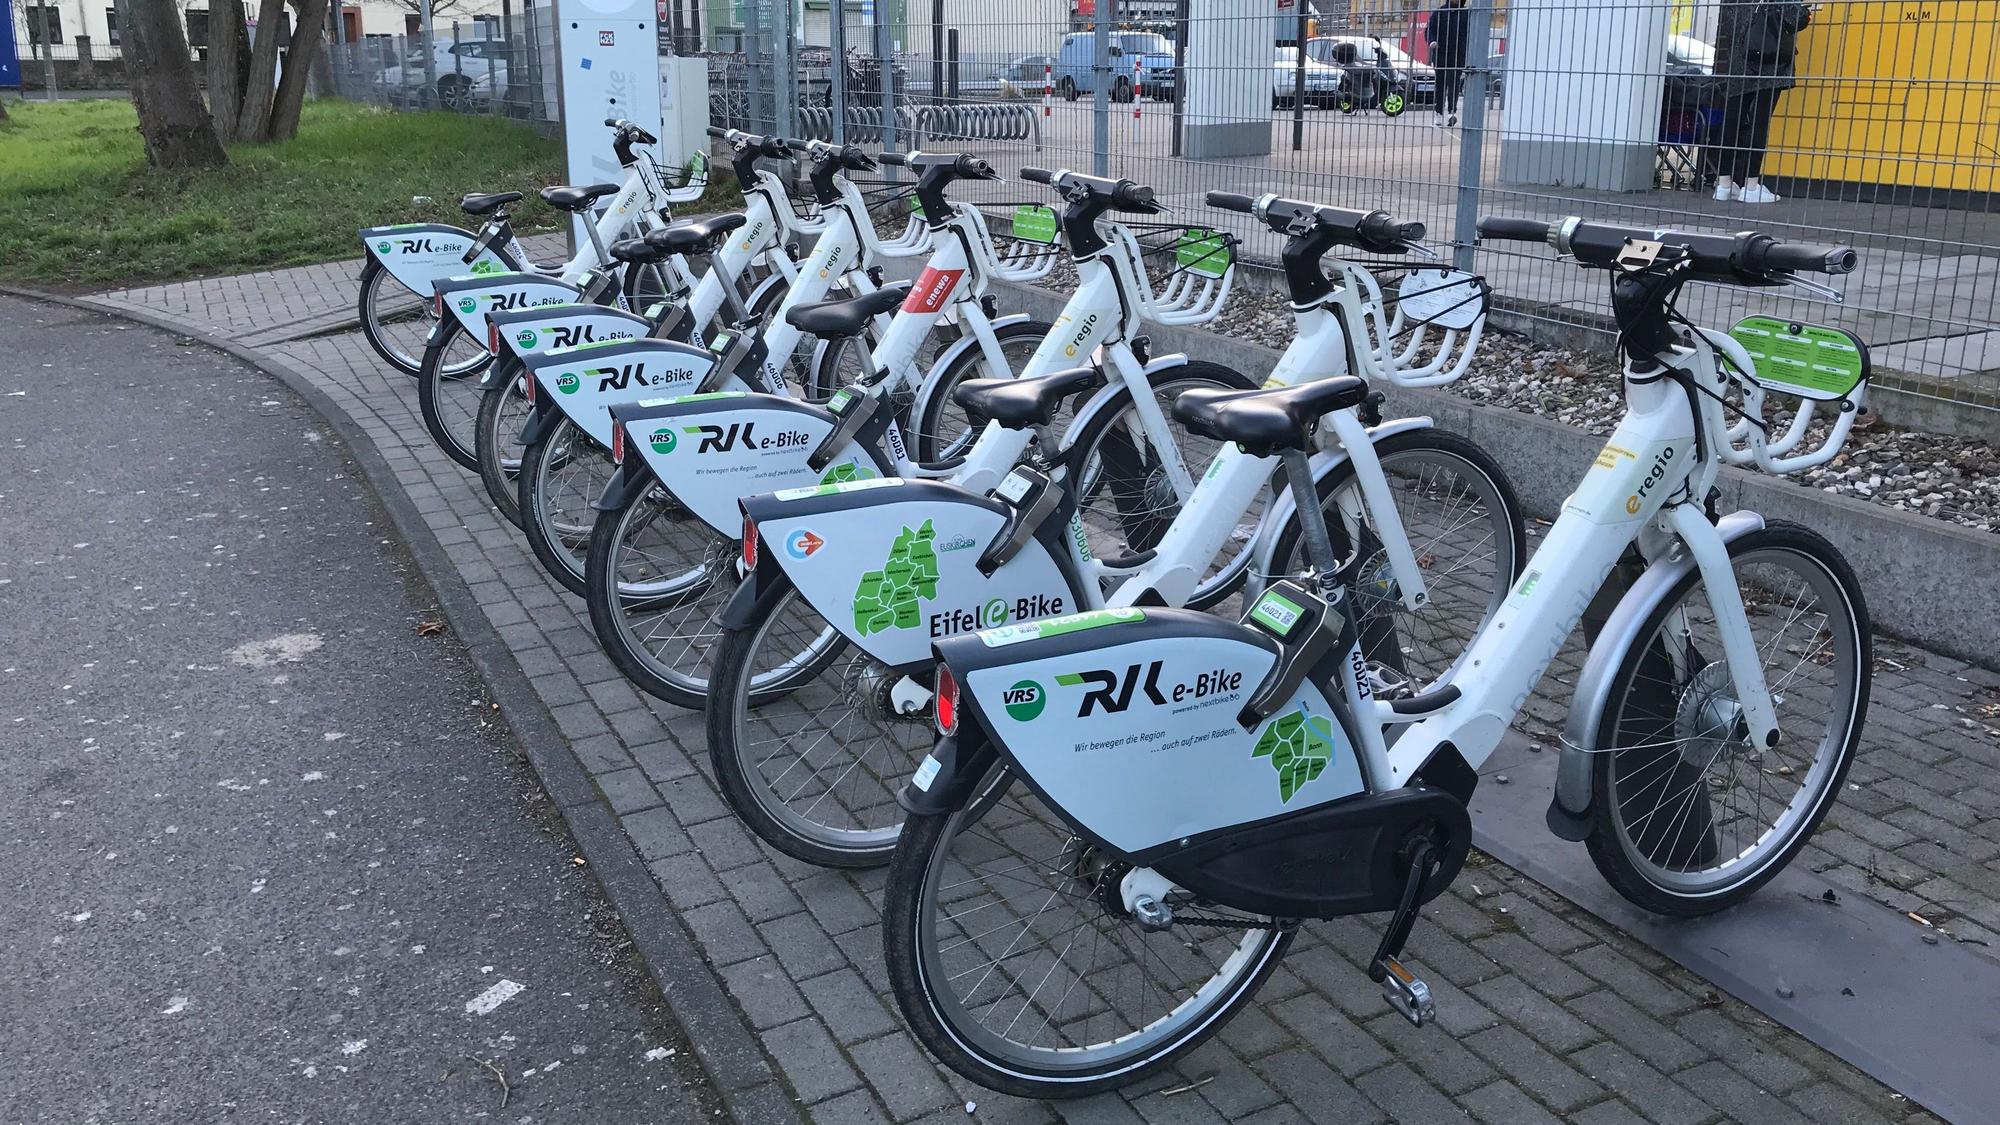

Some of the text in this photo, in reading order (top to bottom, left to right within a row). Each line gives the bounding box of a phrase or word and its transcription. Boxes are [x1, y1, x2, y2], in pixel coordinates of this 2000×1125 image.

[1905, 12, 1918, 20] XL
[434, 243, 462, 253] e-Bike
[458, 300, 472, 308] VRS
[516, 333, 532, 341] VRS
[556, 377, 574, 386] VRS
[652, 368, 693, 385] e-Bike
[767, 362, 783, 391] 46006
[649, 434, 670, 443] VRS
[761, 431, 810, 450] e-Bike
[889, 428, 905, 461] 46081
[705, 467, 729, 476] bewegen
[730, 466, 739, 474] die
[740, 464, 758, 474] Region
[1069, 515, 1091, 562] 530606
[1261, 603, 1282, 619] 46021
[1351, 651, 1371, 700] 46021
[1003, 687, 1036, 704] VRS
[1172, 668, 1242, 703] e-Bike
[1172, 705, 1194, 715] powered
[1199, 695, 1229, 709] nextbike
[1074, 730, 1166, 752] Wir bewegen die Region
[1180, 737, 1194, 750] auf
[1193, 734, 1210, 745] zwei
[1210, 727, 1237, 741] Rädern.
[1308, 742, 1323, 751] Bonn
